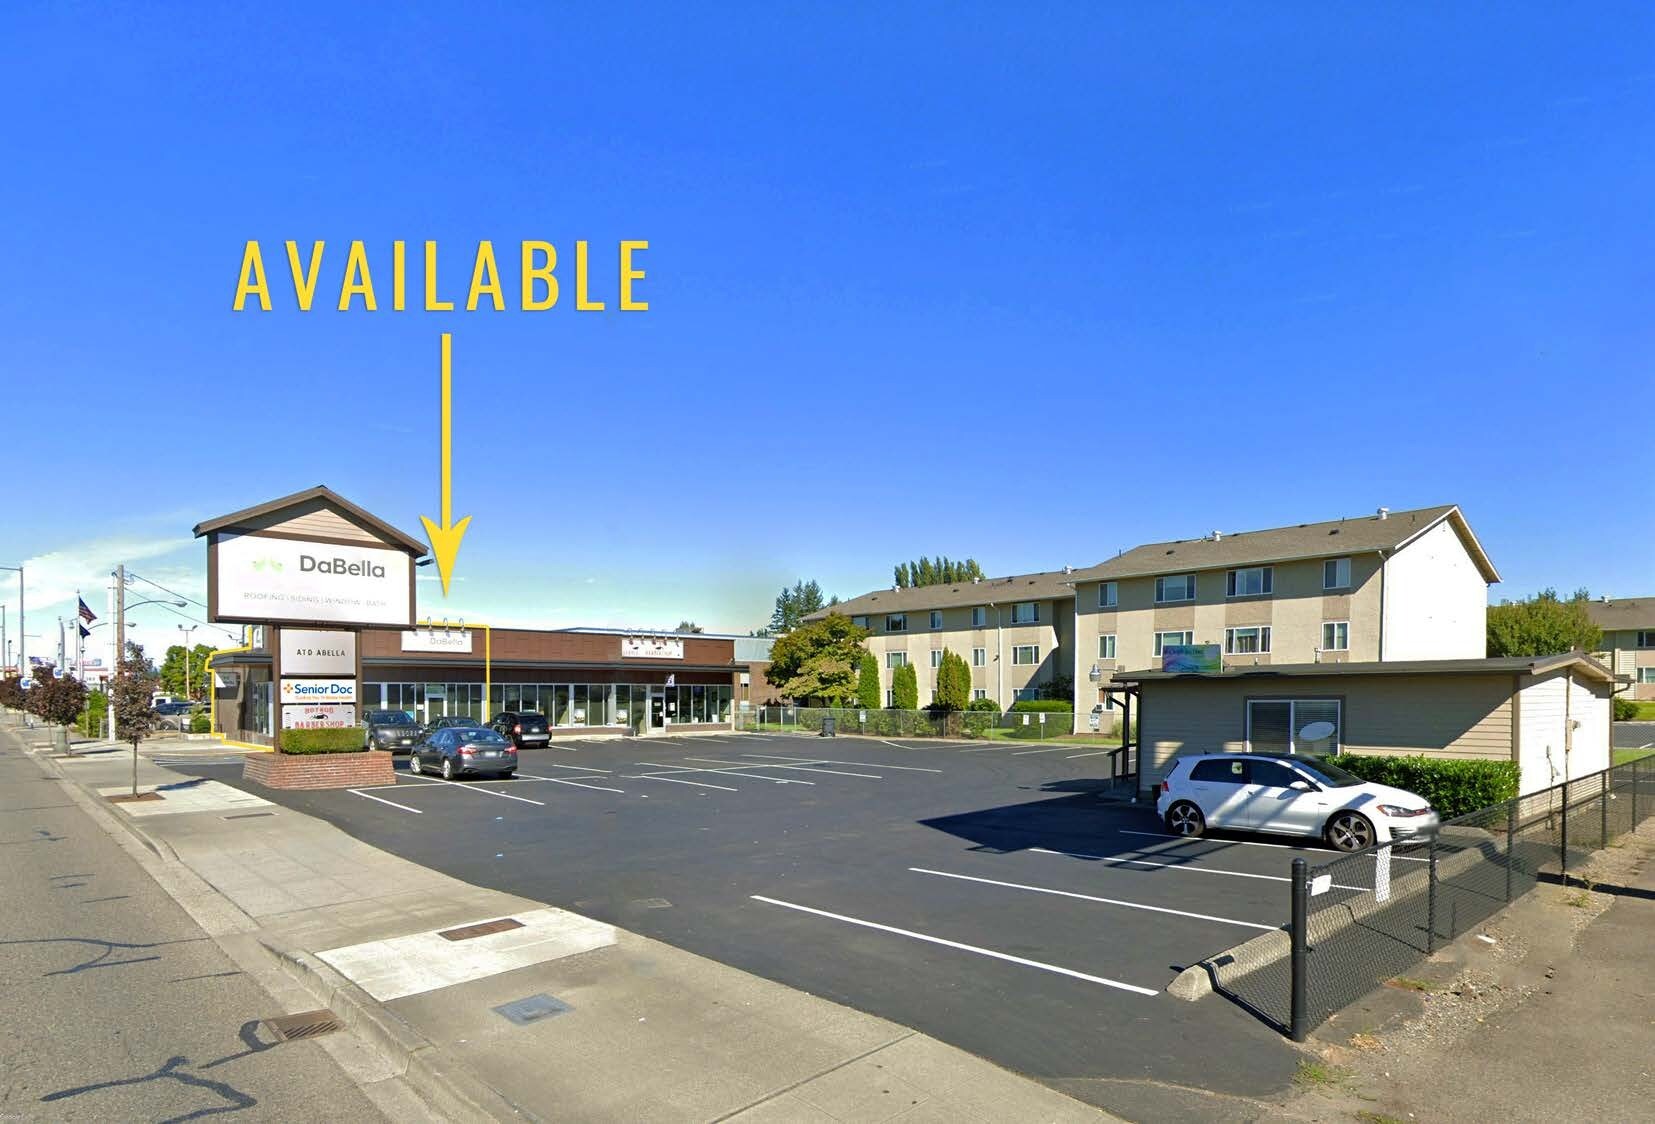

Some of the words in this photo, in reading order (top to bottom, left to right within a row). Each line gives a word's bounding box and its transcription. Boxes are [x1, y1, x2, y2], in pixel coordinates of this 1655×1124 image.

[300, 554, 385, 578] DaBella
[243, 592, 285, 602] ROOFING
[316, 649, 346, 657] ABELLA
[294, 683, 330, 695] Senior
[330, 683, 353, 695] Doc
